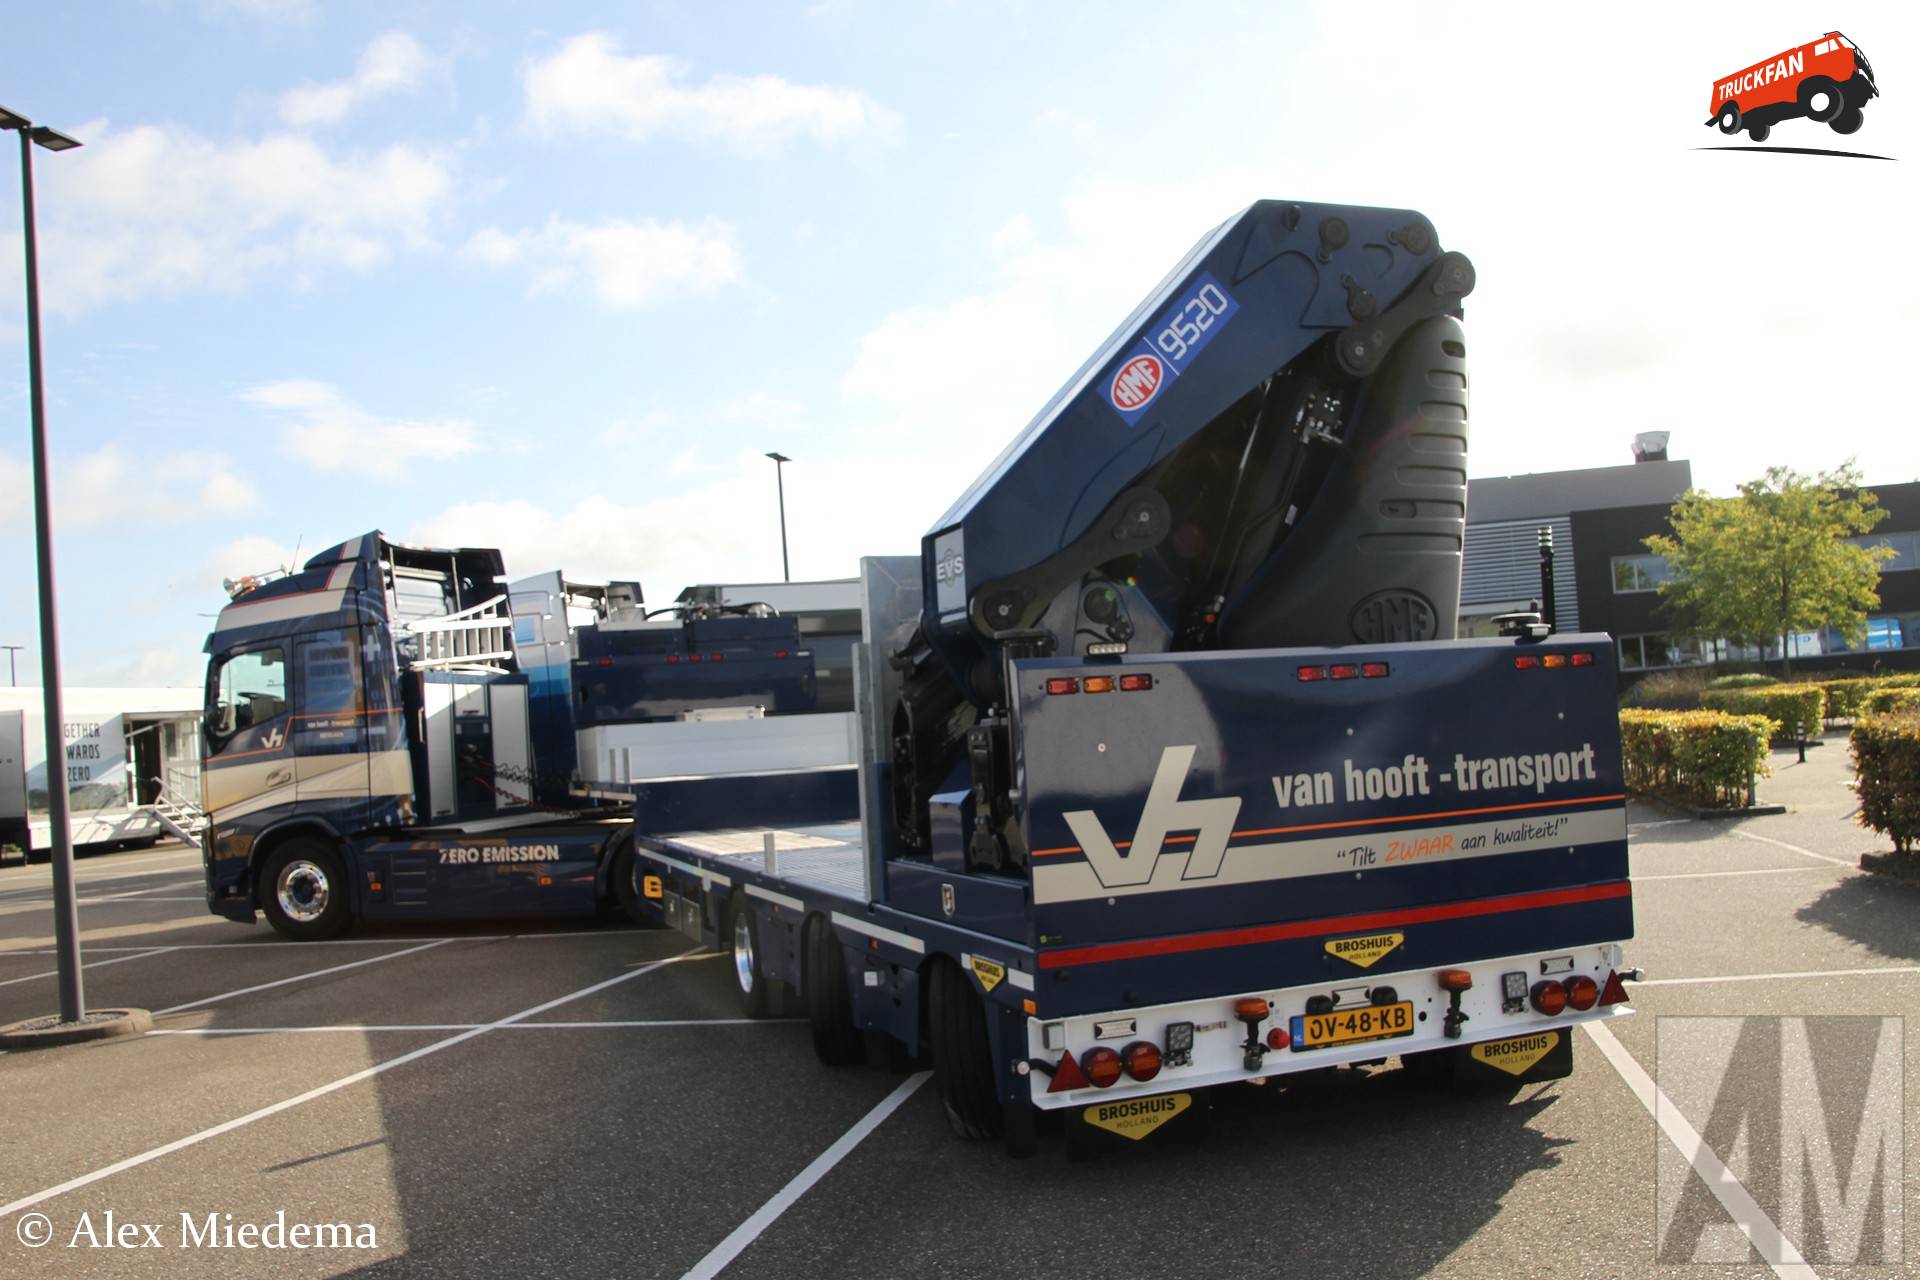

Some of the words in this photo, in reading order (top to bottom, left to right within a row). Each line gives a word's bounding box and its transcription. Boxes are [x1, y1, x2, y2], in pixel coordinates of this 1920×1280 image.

[1115, 358, 1158, 407] HMF
[1158, 283, 1228, 361] 9520
[936, 556, 964, 581] EVS
[64, 723, 101, 738] GETHER
[66, 744, 100, 760] WARDS
[67, 766, 91, 782] ZERO
[1272, 769, 1334, 808] van
[1344, 754, 1430, 802] hooft
[439, 848, 479, 864] ZERO
[482, 844, 560, 863] EMISSION
[1384, 834, 1456, 864] ZWAAR
[1461, 836, 1486, 851] aan
[1335, 936, 1394, 953] BROSHUIS
[1310, 1007, 1406, 1040] OV-48-KB
[1484, 1036, 1548, 1057] BROSHUIS
[1499, 1054, 1535, 1065] HOLLAND
[1099, 1097, 1176, 1121] BROSHUIS
[1116, 1115, 1159, 1129] HOLLAND
